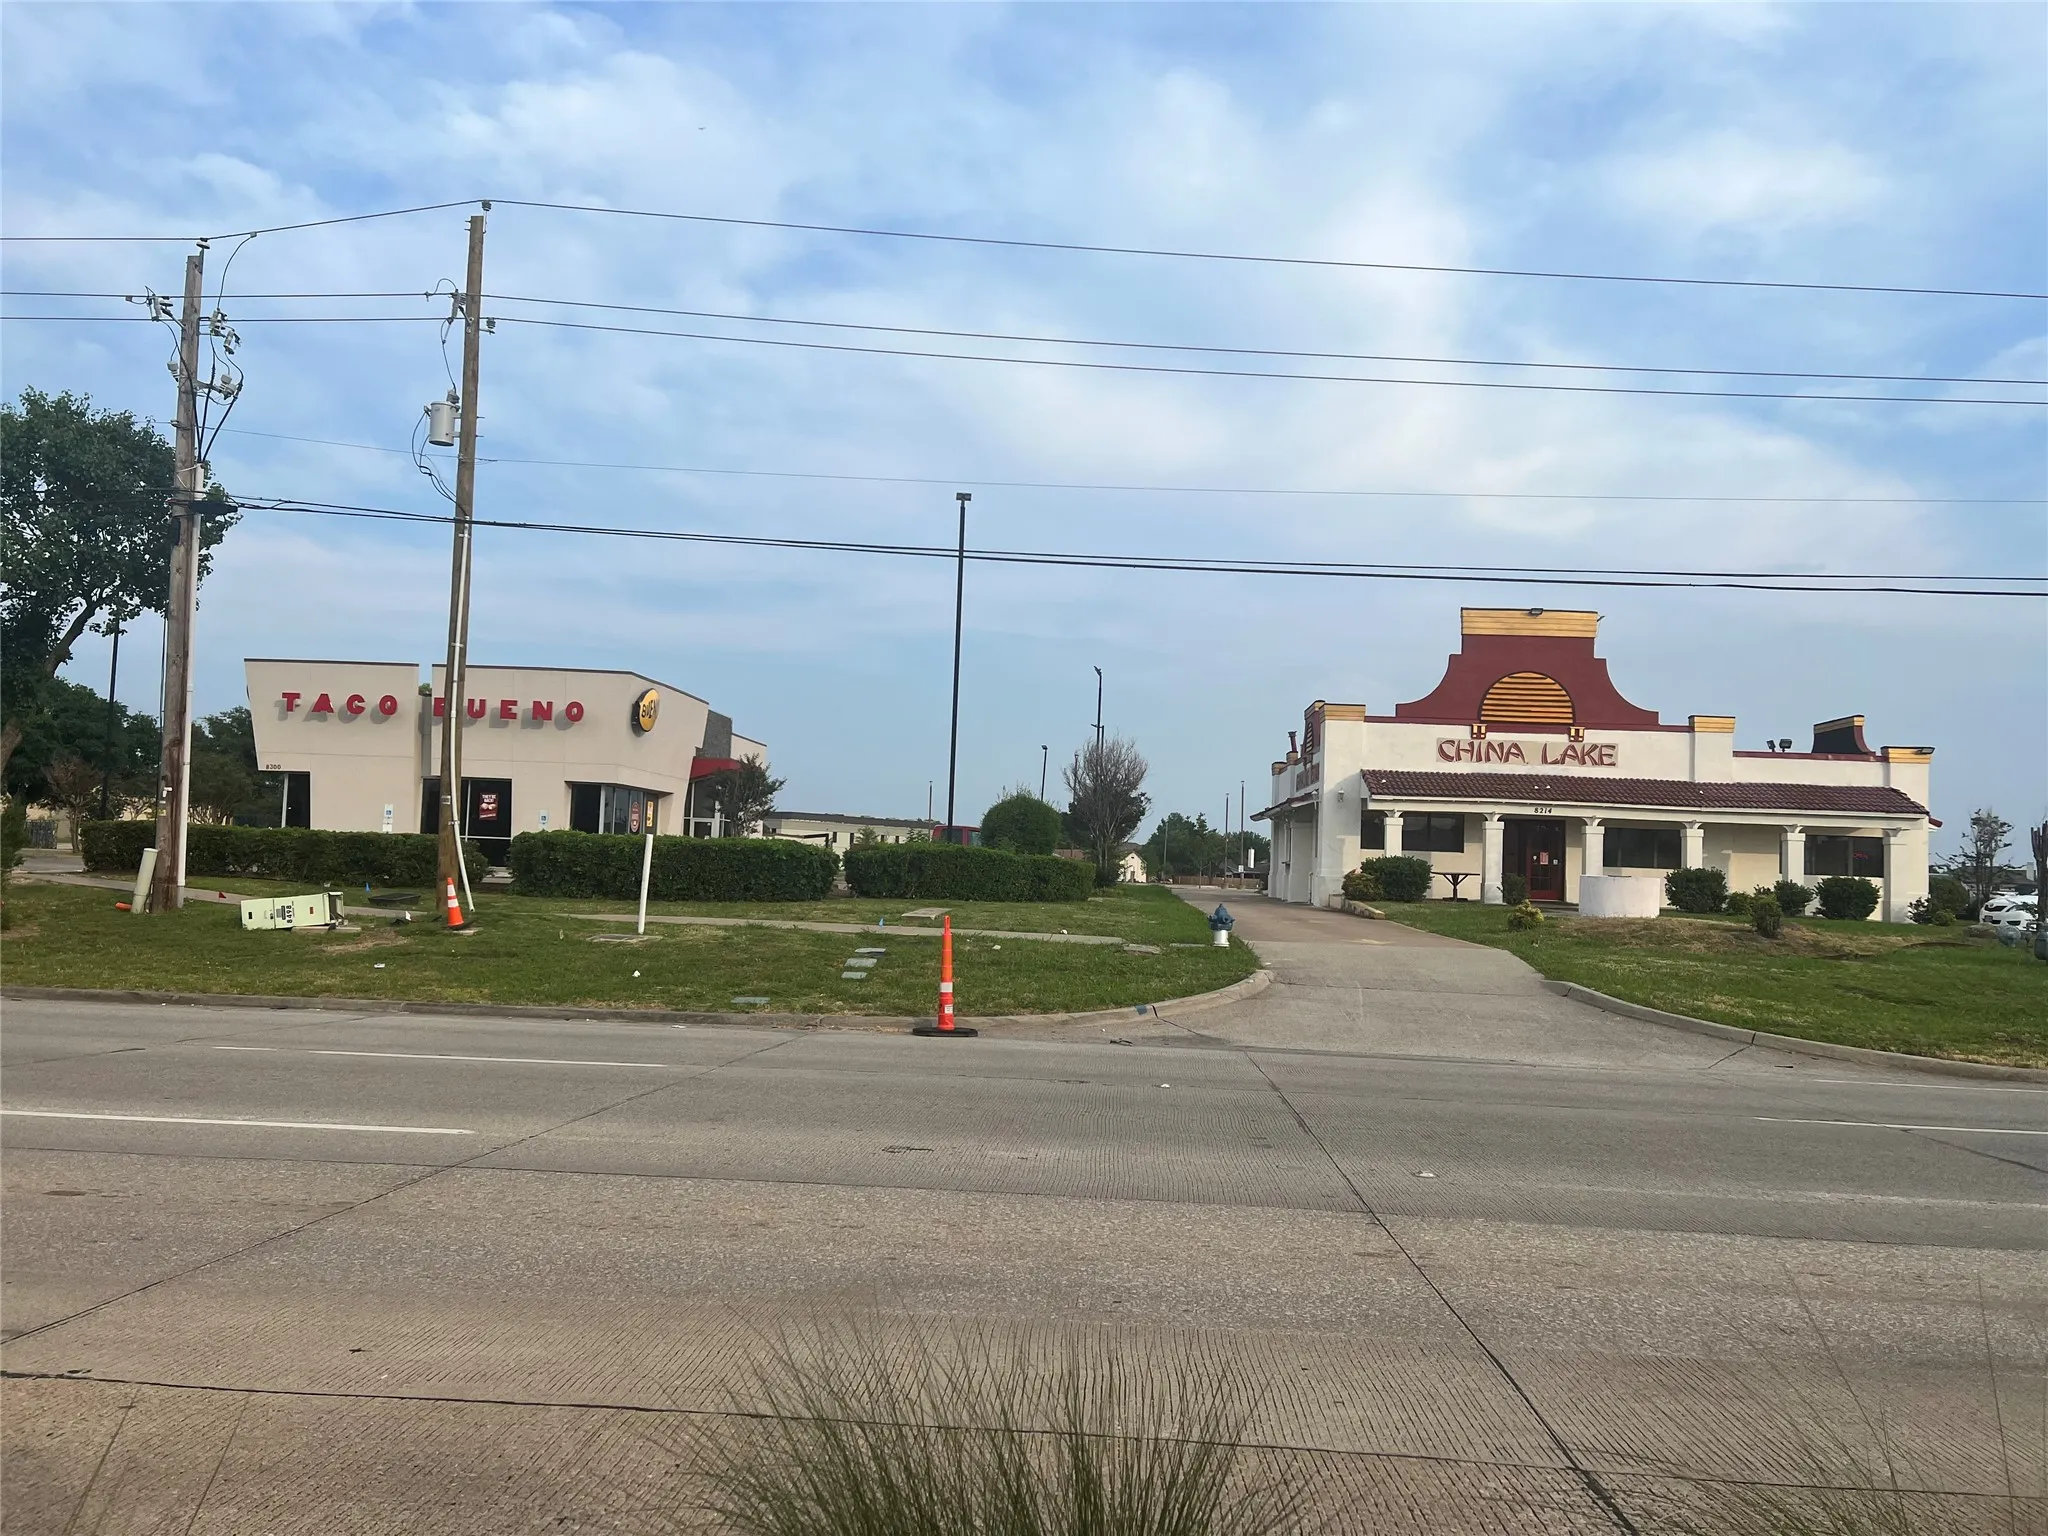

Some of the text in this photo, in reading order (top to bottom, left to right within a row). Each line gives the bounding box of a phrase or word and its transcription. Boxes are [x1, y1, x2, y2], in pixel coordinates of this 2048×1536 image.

[282, 692, 398, 716] TACO
[1437, 739, 1617, 767] CHINA LAKE
